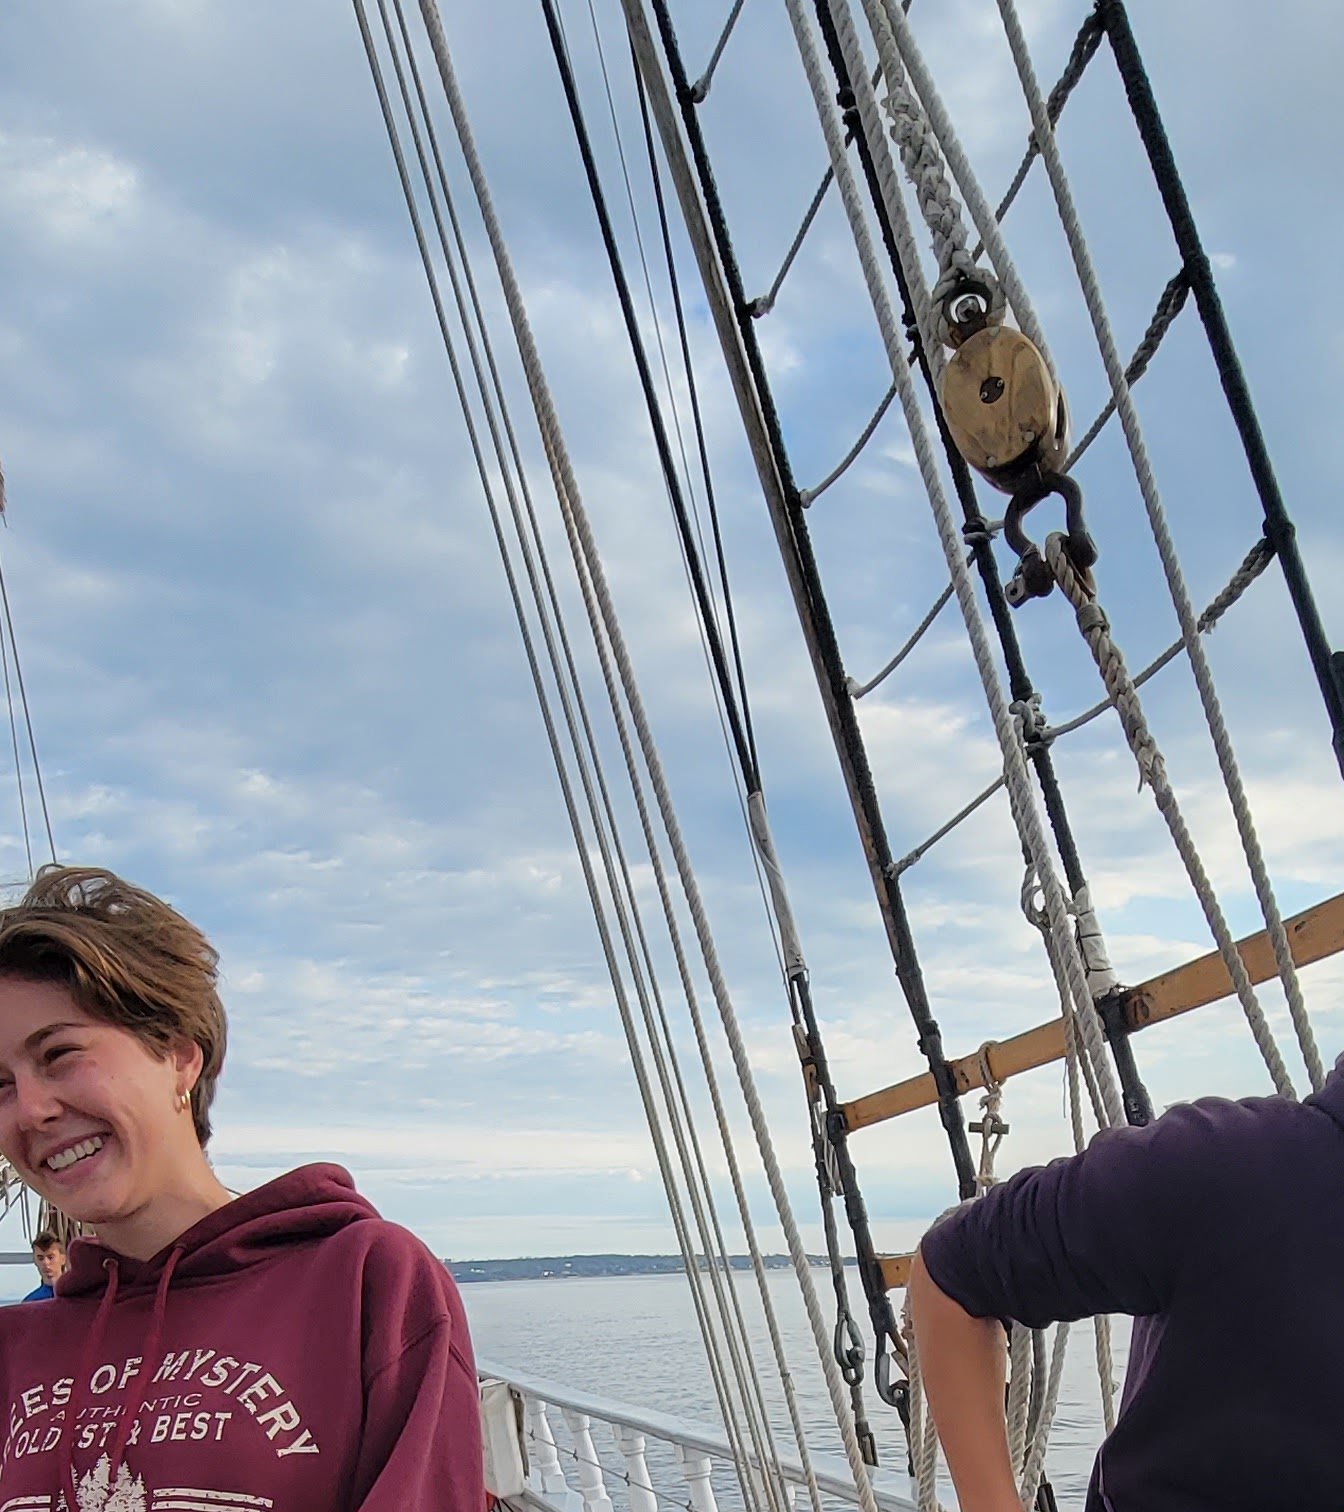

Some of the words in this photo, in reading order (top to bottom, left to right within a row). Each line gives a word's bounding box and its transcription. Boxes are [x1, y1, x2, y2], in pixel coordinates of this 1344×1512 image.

[51, 1393, 202, 1421] AUTHNTIC
[90, 1357, 143, 1394] OF
[152, 1349, 319, 1458] MYSTERY
[14, 1421, 117, 1459] OLDST
[151, 1412, 232, 1443] BEST
